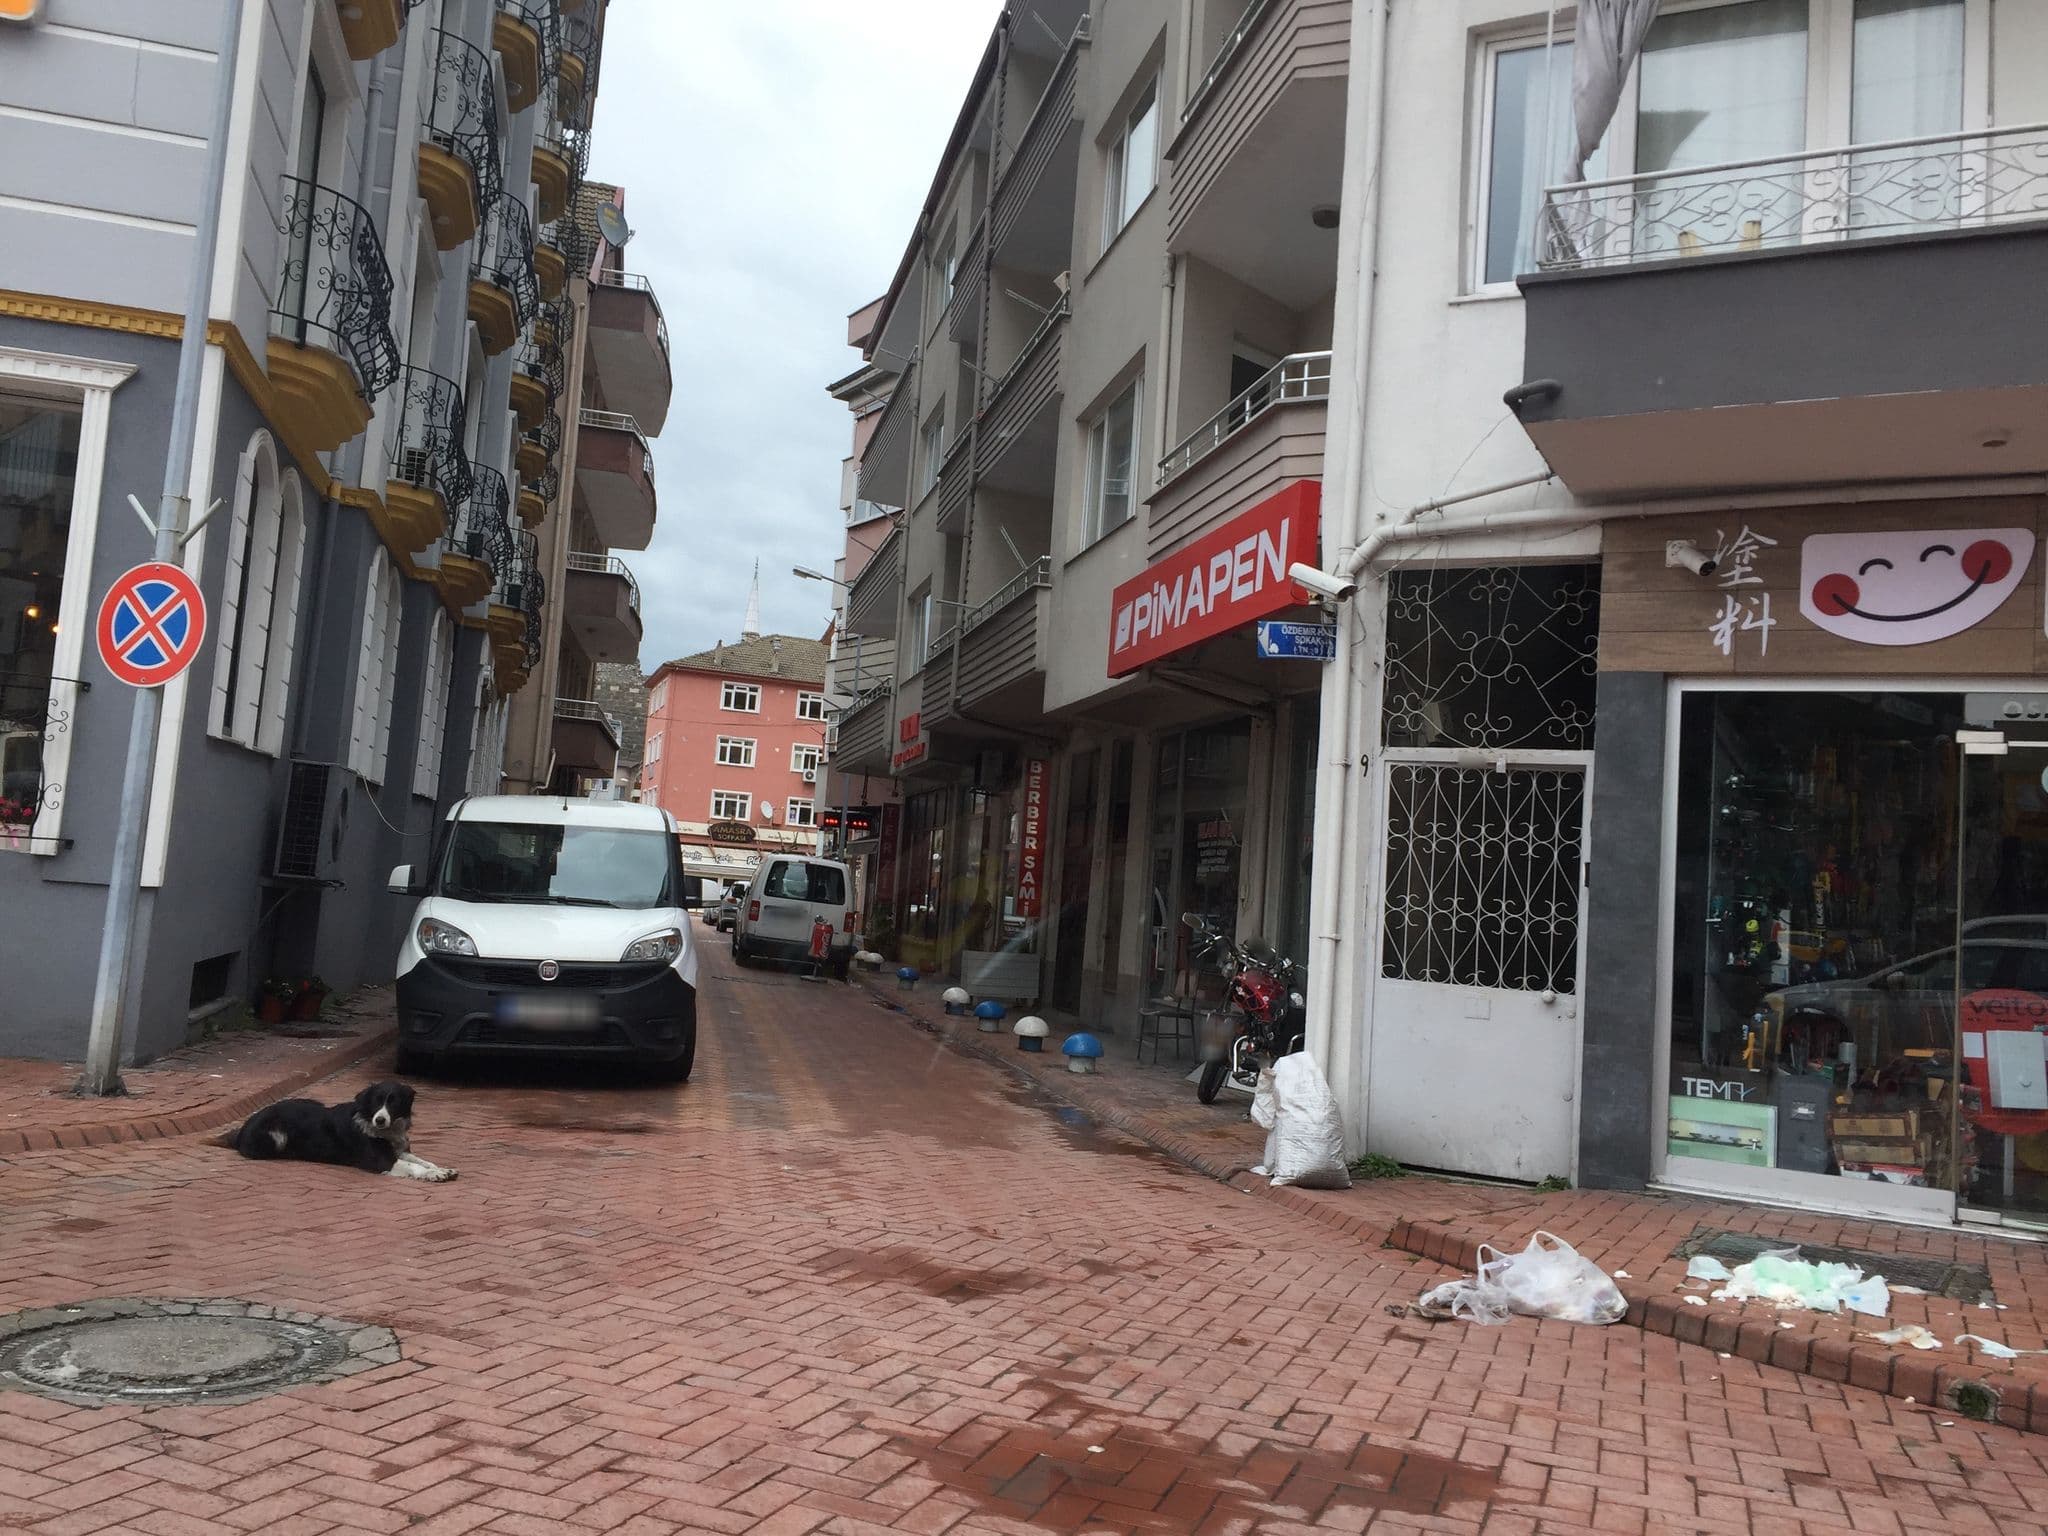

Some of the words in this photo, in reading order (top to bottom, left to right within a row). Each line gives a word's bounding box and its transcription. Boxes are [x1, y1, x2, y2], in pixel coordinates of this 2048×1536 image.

[1131, 517, 1290, 647] PİMAPEN
[712, 826, 753, 836] AMASRA
[1024, 760, 1042, 850] BERBER
